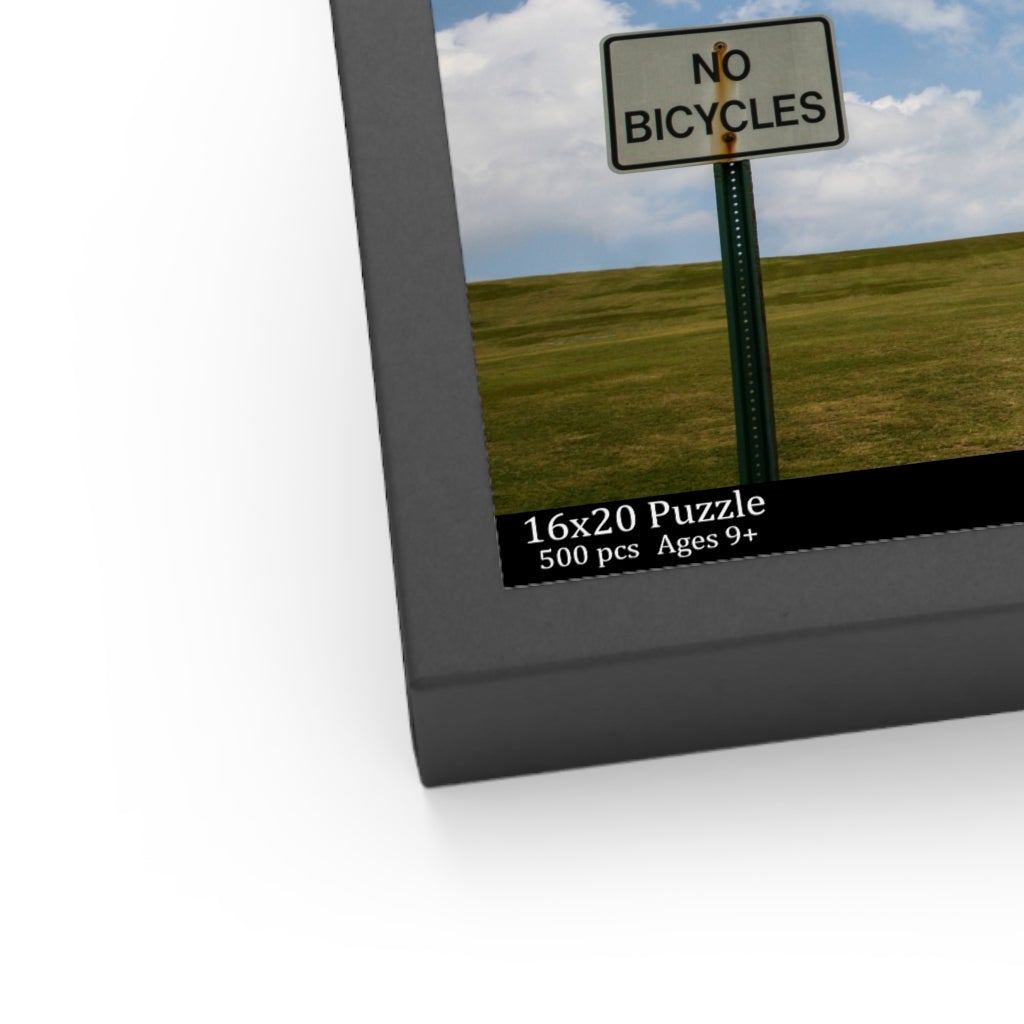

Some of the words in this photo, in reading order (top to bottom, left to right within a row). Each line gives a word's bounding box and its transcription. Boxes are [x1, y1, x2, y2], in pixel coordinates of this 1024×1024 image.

[692, 49, 751, 85] NO
[624, 91, 826, 144] BICYCLES
[523, 504, 637, 544] 16x20
[648, 489, 766, 529] Puzzle
[539, 544, 589, 570] 500
[596, 543, 640, 568] pcs
[657, 533, 719, 558] Ages
[725, 526, 758, 546] 9+
